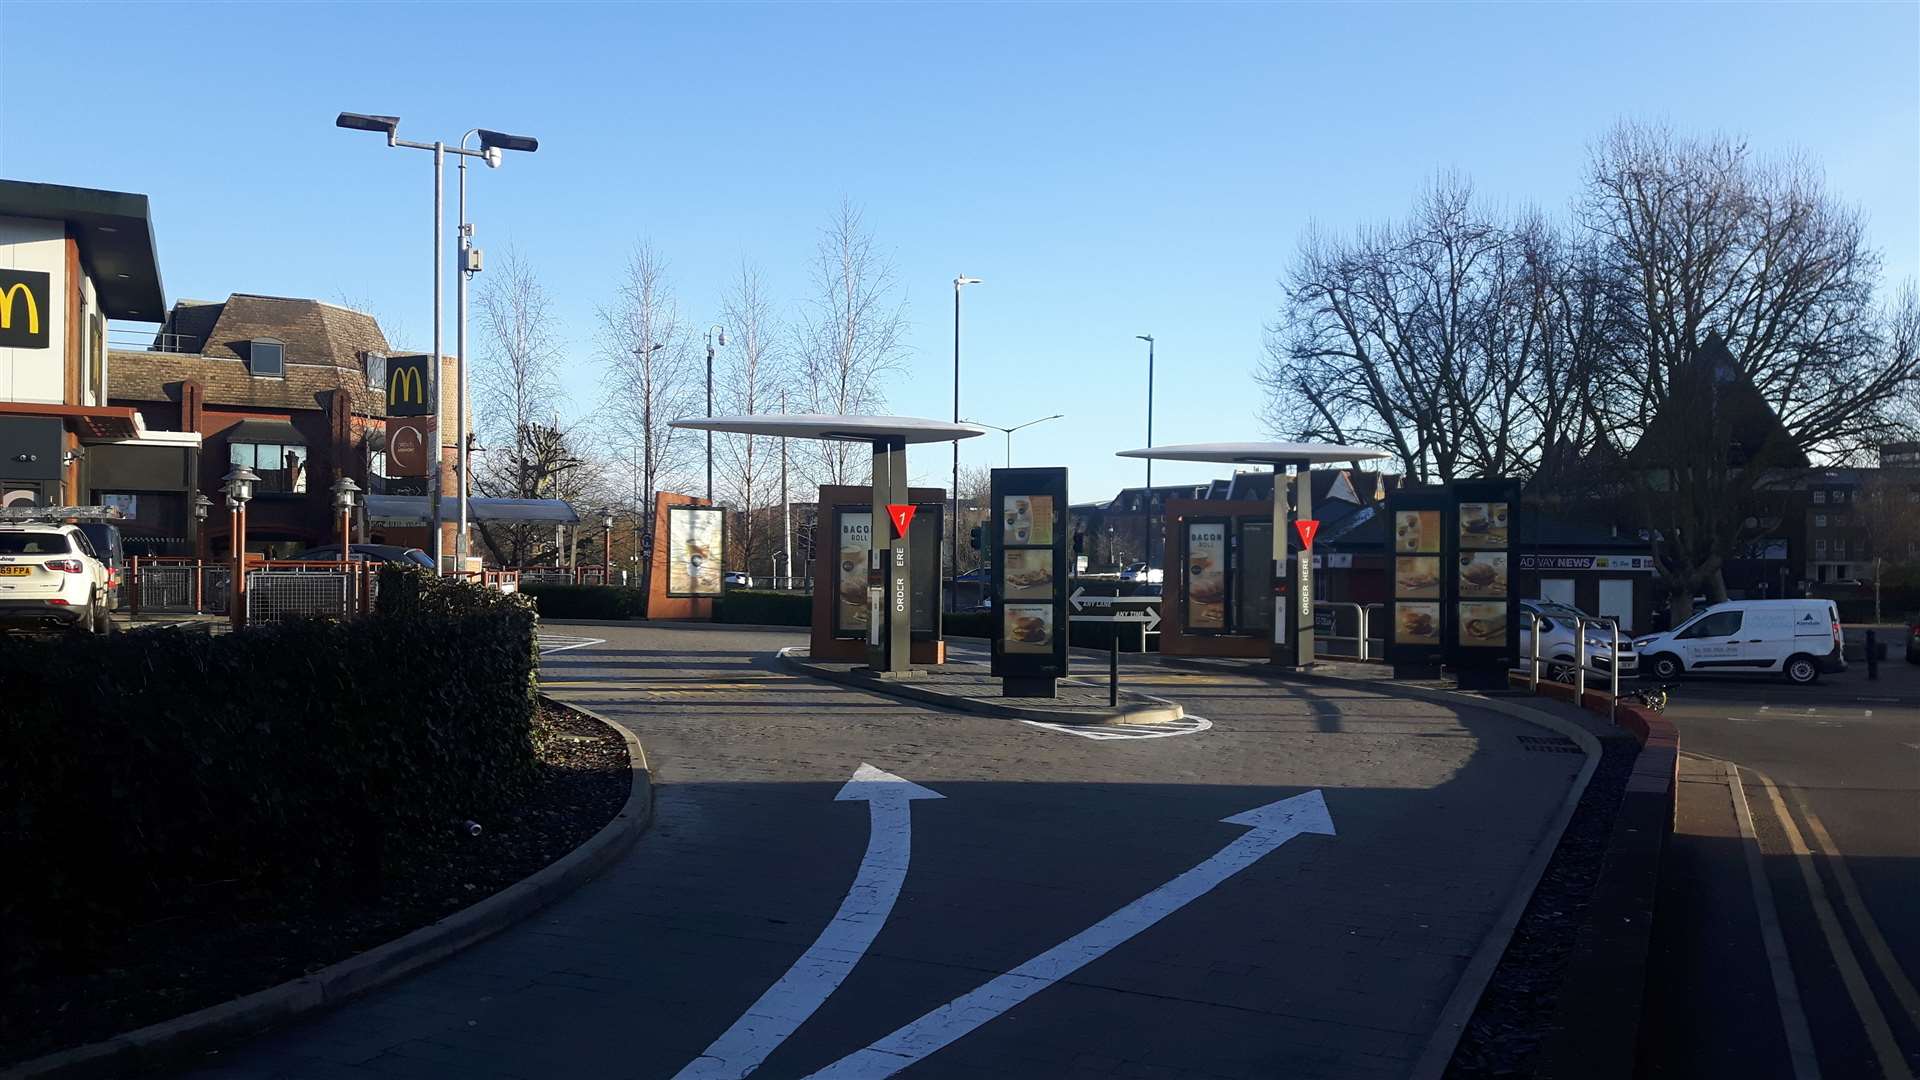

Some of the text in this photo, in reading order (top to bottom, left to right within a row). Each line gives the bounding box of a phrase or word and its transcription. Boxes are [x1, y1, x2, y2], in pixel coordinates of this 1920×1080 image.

[843, 525, 873, 534] BACO
[1557, 558, 1591, 568] NEWS
[13, 567, 31, 575] FPA
[1302, 557, 1310, 616] ORDER HERE
